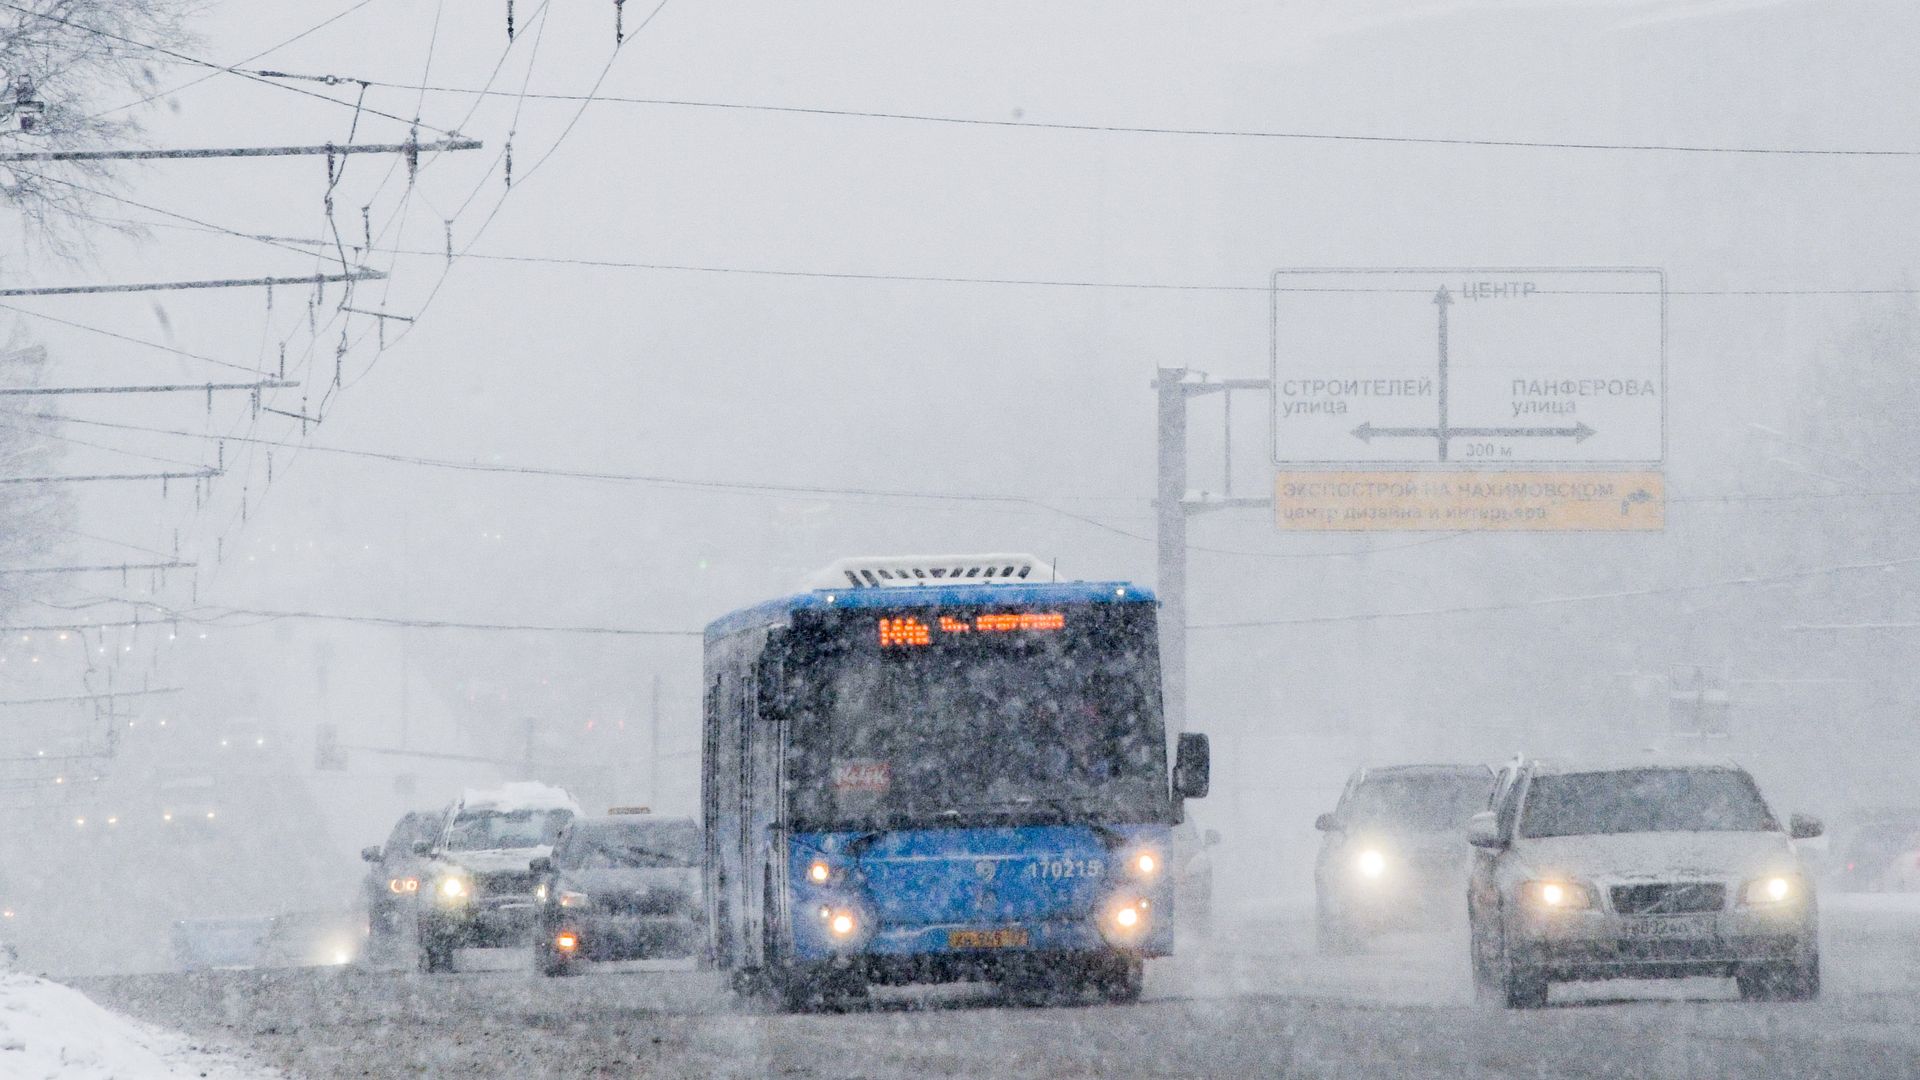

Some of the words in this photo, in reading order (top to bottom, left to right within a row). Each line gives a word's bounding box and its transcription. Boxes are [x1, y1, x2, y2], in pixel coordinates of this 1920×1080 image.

[1463, 281, 1537, 301] ЦЕНТР
[1283, 377, 1433, 397] СТРОИТЕЛЕЙ
[1512, 379, 1655, 396] ПАНФЕРОВА
[1283, 401, 1348, 417] улица
[1512, 401, 1577, 417] улица
[1466, 443, 1494, 457] 300
[1284, 480, 1417, 498] ЭКСПОСТРОЙ
